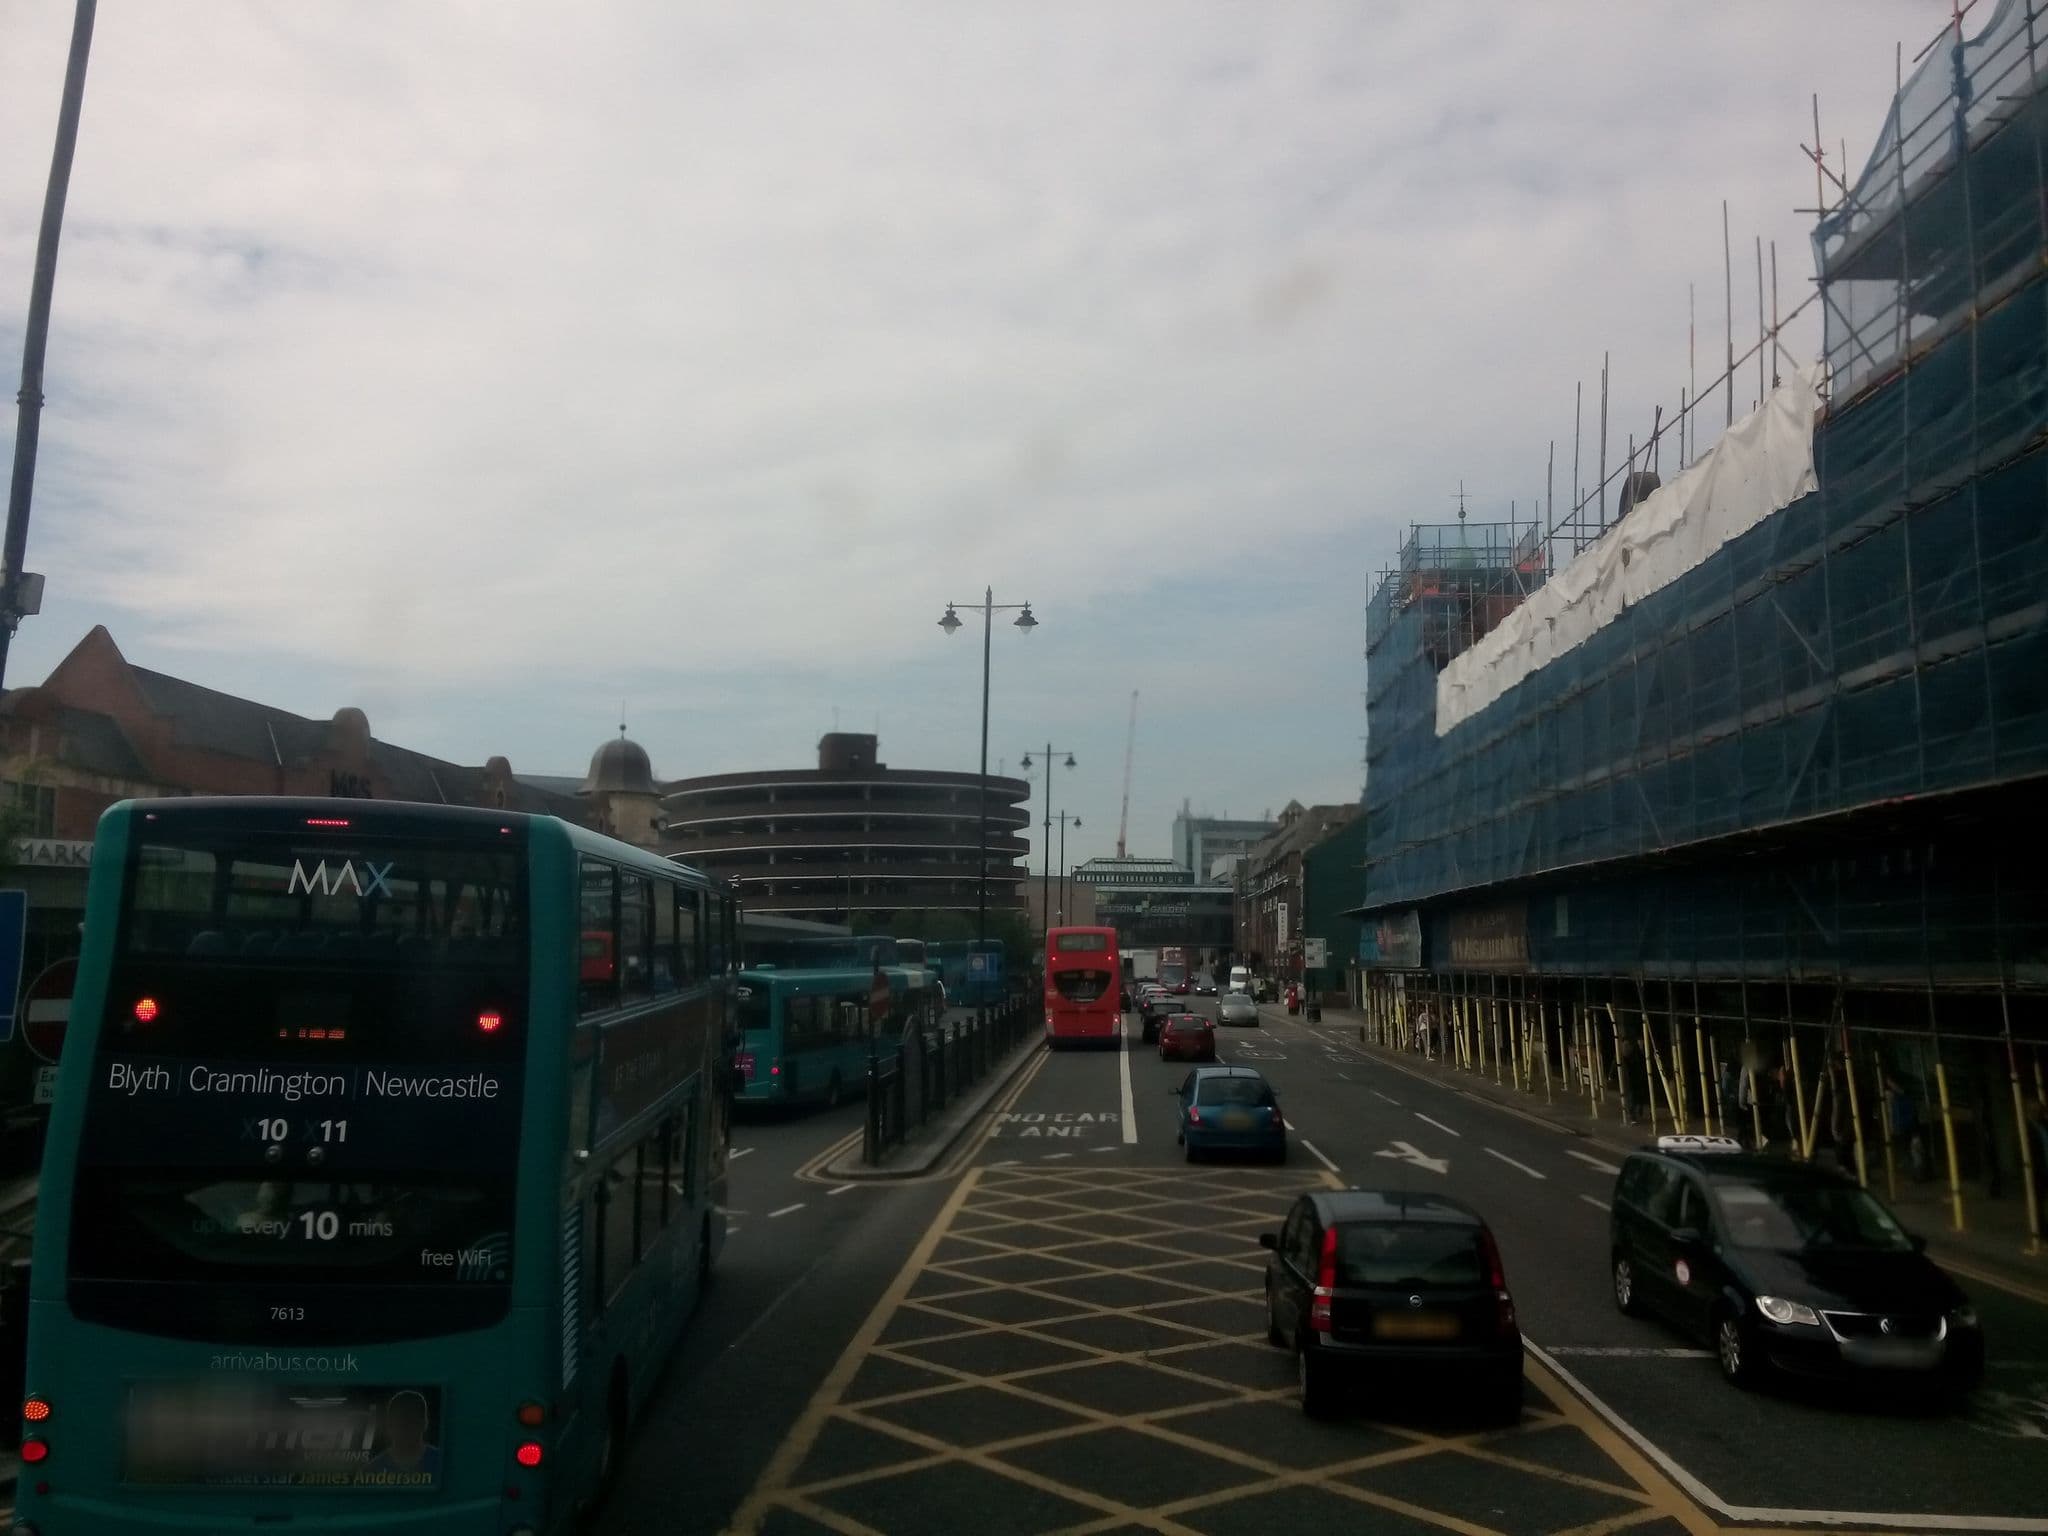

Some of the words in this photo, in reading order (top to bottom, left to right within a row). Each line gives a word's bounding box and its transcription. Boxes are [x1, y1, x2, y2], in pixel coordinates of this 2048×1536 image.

[287, 858, 394, 897] MAX
[109, 1063, 170, 1096] Blyth
[189, 1066, 346, 1101] Cramlington
[365, 1070, 499, 1098] Newcastle
[1053, 1112, 1119, 1123] CAR
[1667, 1136, 1733, 1145] TAXI
[240, 1219, 291, 1240] every
[299, 1210, 339, 1240] 10
[348, 1219, 393, 1237] mins
[420, 1248, 455, 1266] free
[457, 1248, 493, 1266] WiFi
[270, 1307, 305, 1321] 7613
[210, 1352, 360, 1372] arrivabus.co.uk
[297, 1470, 350, 1486] James
[353, 1468, 433, 1486] Anderson
